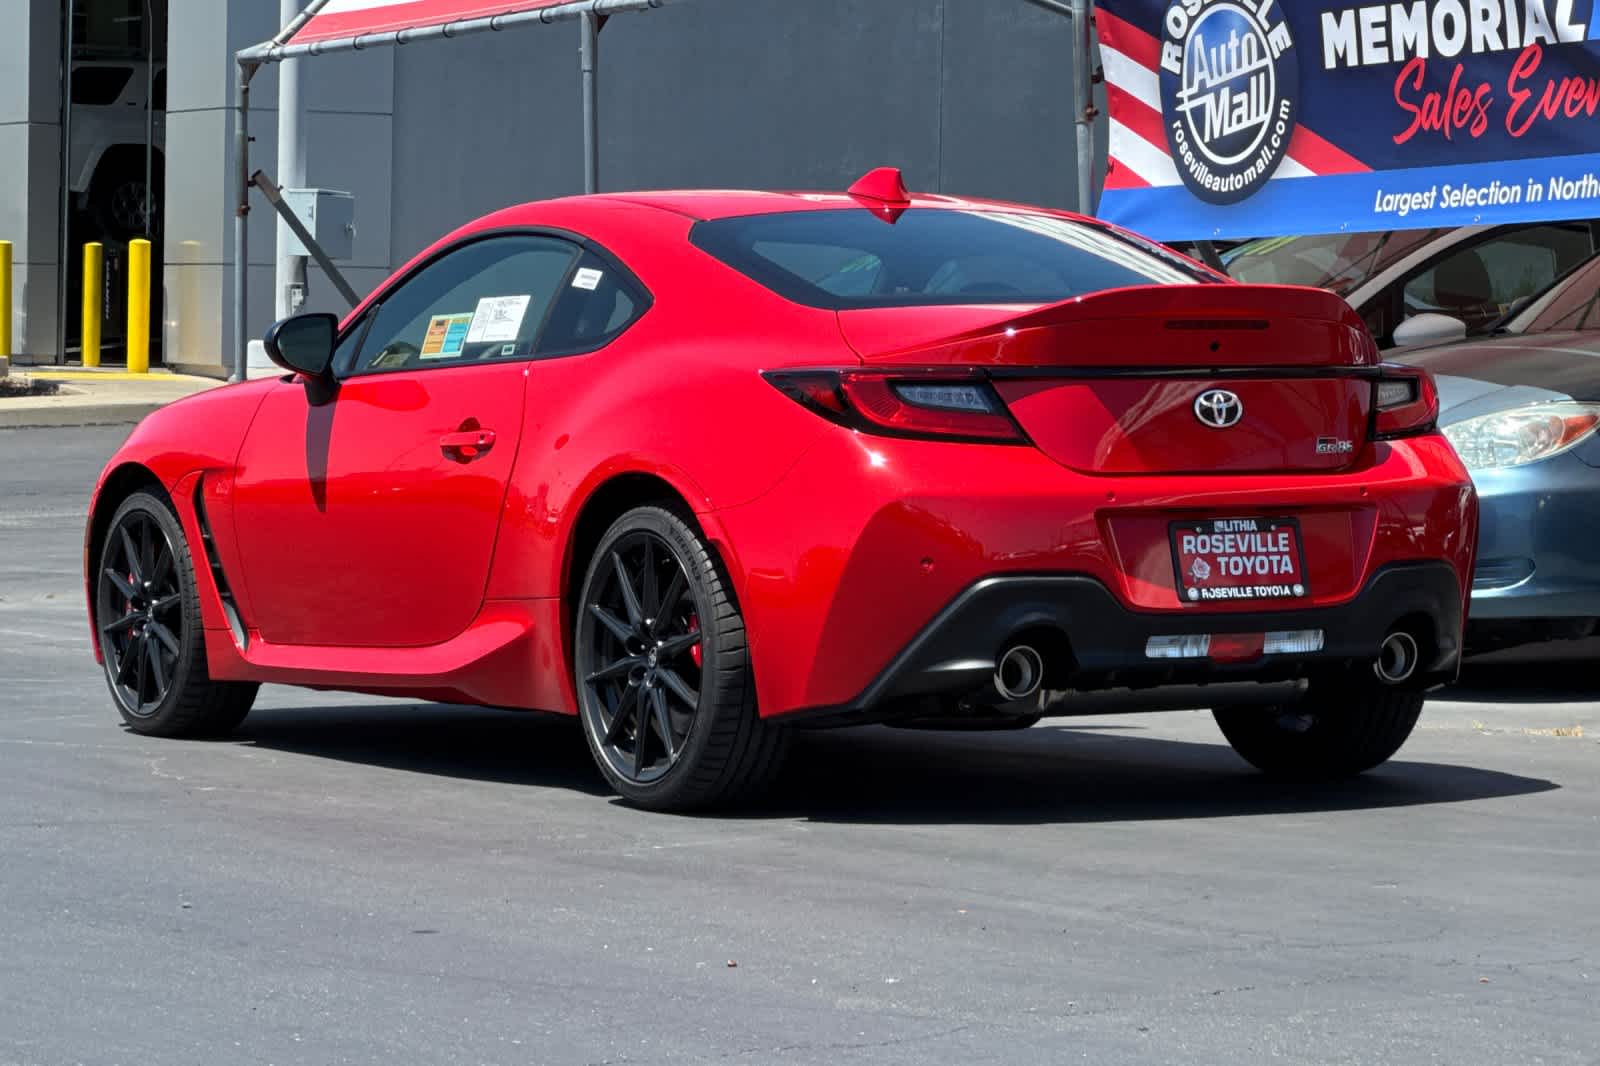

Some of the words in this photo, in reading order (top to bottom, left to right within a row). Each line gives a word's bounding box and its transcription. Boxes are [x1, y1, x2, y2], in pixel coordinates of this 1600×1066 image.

[1160, 0, 1292, 75] ROSLE
[1182, 29, 1268, 96] Auto
[1321, 0, 1586, 69] MEMORIAL
[1186, 72, 1268, 143] Mall
[1393, 57, 1493, 144] Sales
[1173, 99, 1290, 192] rosevilleautomall.com
[1374, 185, 1437, 216] Largest
[1440, 180, 1521, 208] Selection
[1525, 177, 1543, 203] in
[1547, 173, 1600, 201] North
[1183, 533, 1290, 554] ROSEVILLE
[1224, 520, 1257, 532] LITHIA
[1217, 555, 1294, 576] TOYOTA
